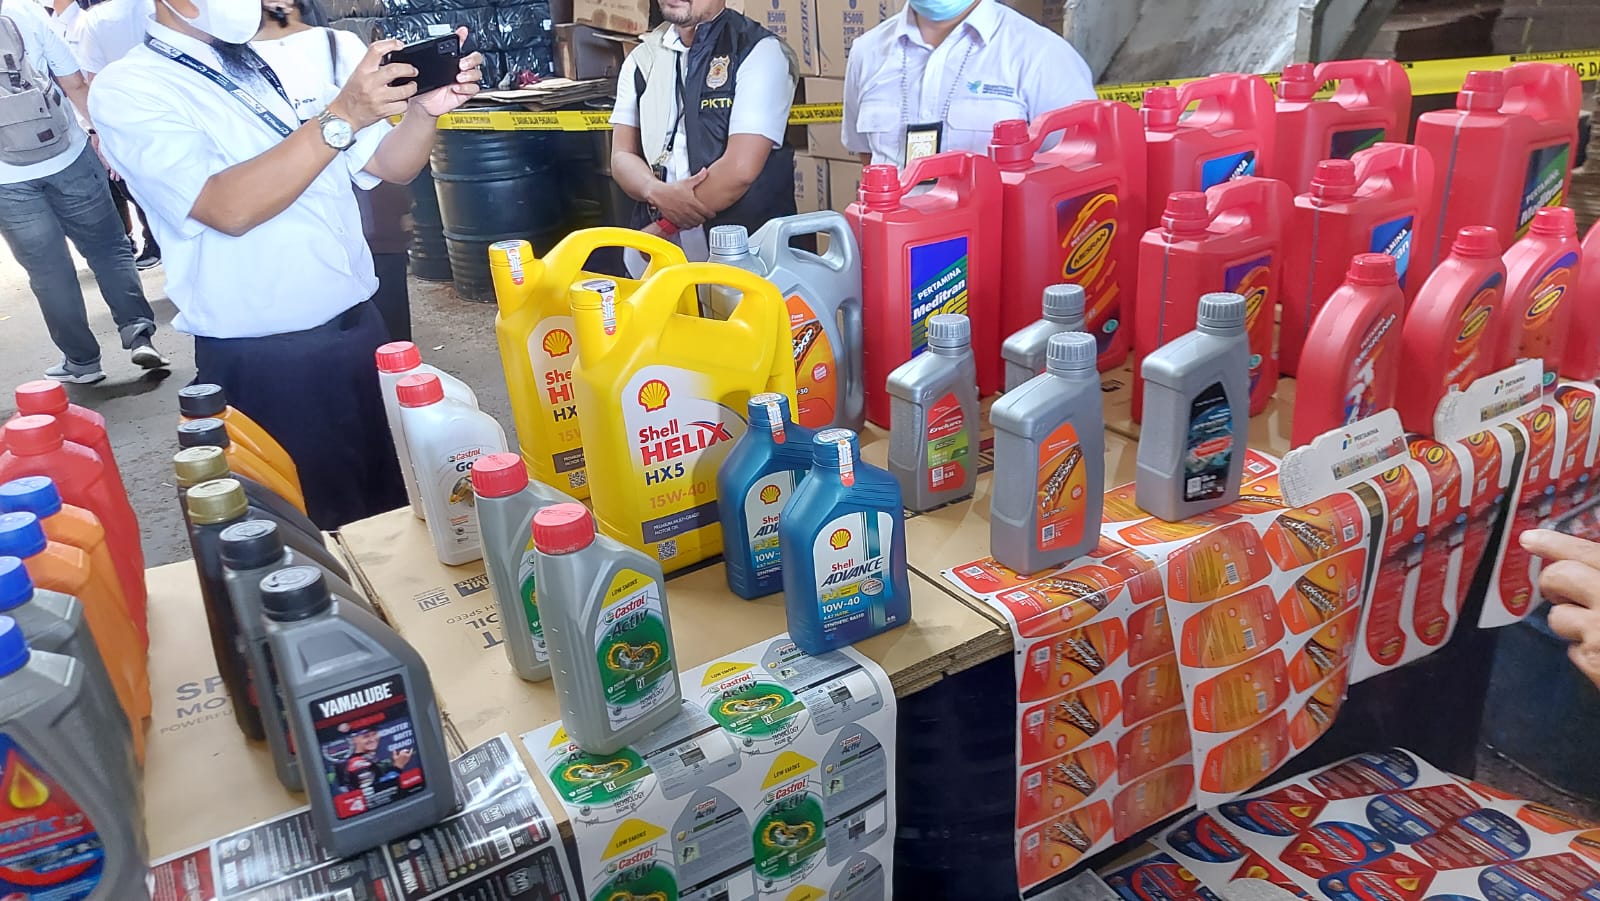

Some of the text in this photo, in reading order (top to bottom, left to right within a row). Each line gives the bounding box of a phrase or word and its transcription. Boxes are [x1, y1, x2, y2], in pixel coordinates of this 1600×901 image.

[917, 266, 962, 301] PERTAMINA
[913, 279, 966, 322] Meditran
[638, 418, 679, 444] Shell
[640, 422, 733, 466] HELIX
[456, 447, 481, 461] Castrol
[645, 462, 685, 486] HX5
[649, 481, 705, 509] 15W-40
[821, 556, 883, 587] ADVANCE
[831, 559, 854, 572] Shell
[611, 587, 622, 597] LOW
[614, 595, 645, 619] Castrol
[822, 596, 860, 614] 10W-40
[446, 608, 483, 625] SPEED
[611, 608, 649, 638] Activ
[637, 677, 646, 690] 2T
[711, 671, 721, 679] LOW
[720, 674, 750, 691] Castrol
[319, 682, 393, 718] YAMALUBE
[722, 681, 757, 700] Activ
[772, 726, 800, 741] TECHNOLOGY
[773, 770, 784, 779] LOW
[606, 781, 617, 790] 2T
[775, 779, 807, 800] Castrol
[614, 791, 645, 809] TECHNOLOGY
[773, 792, 808, 815] Activ
[616, 839, 627, 848] LOW
[618, 847, 654, 870] Castrol
